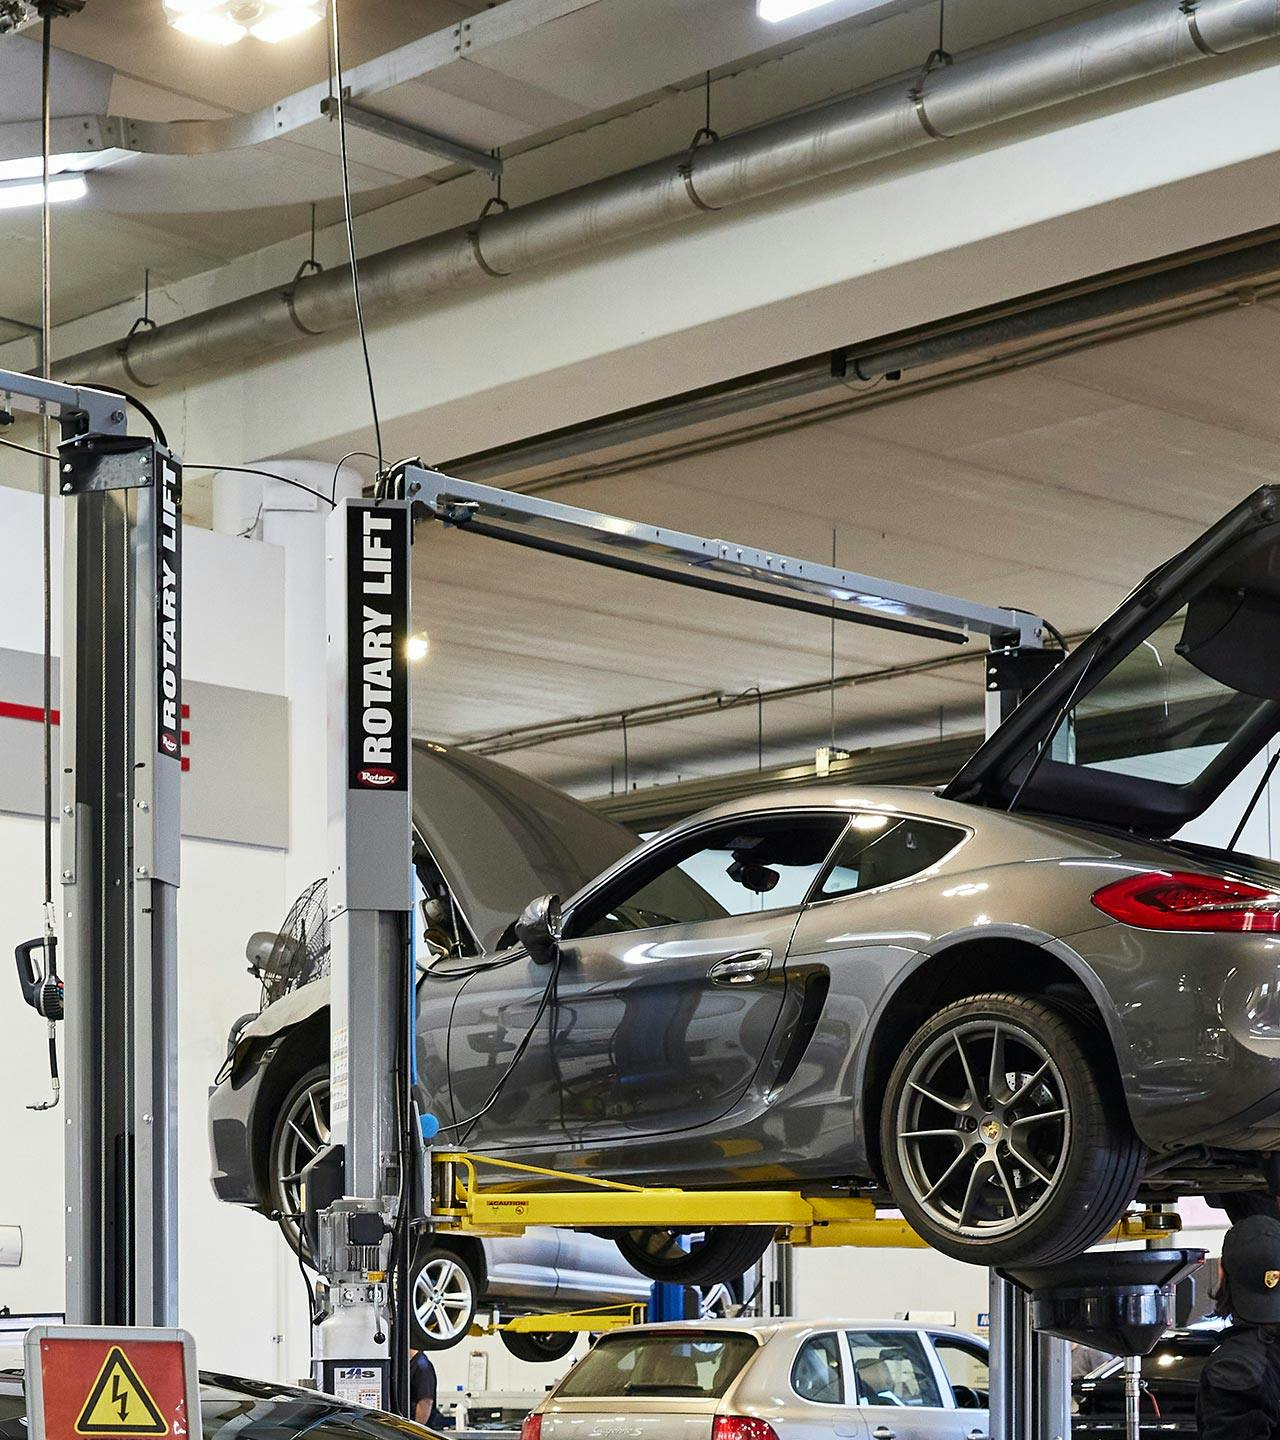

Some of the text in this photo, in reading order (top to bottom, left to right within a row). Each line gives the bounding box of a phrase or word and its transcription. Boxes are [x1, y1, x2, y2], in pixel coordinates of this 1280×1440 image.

[162, 460, 177, 730] ROTARY LIFT
[362, 511, 393, 764] ROTARY LIFT
[360, 771, 395, 785] Rotary
